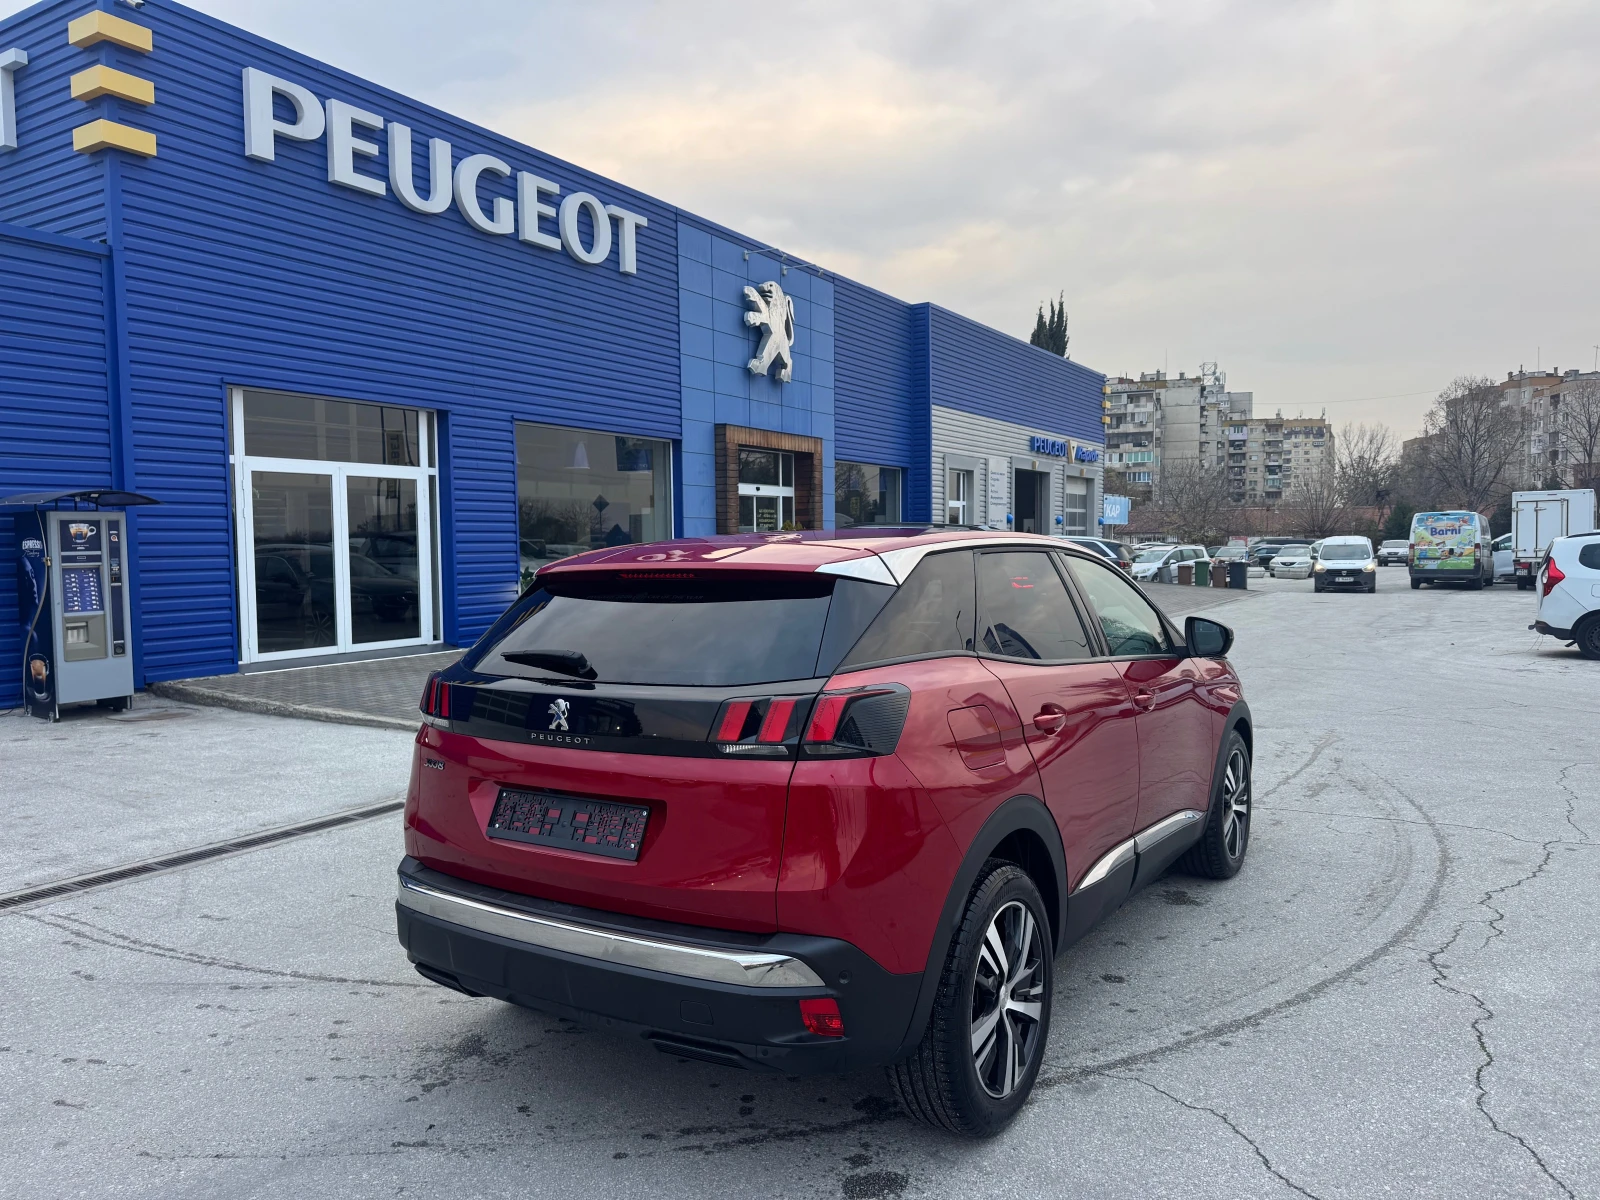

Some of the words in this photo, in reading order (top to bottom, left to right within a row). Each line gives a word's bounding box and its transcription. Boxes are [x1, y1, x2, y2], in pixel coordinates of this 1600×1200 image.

[242, 66, 649, 275] PEUGEOT
[1030, 436, 1068, 458] PEUGEOT
[1430, 526, 1461, 536] Barni
[531, 732, 590, 745] PEUGEOT
